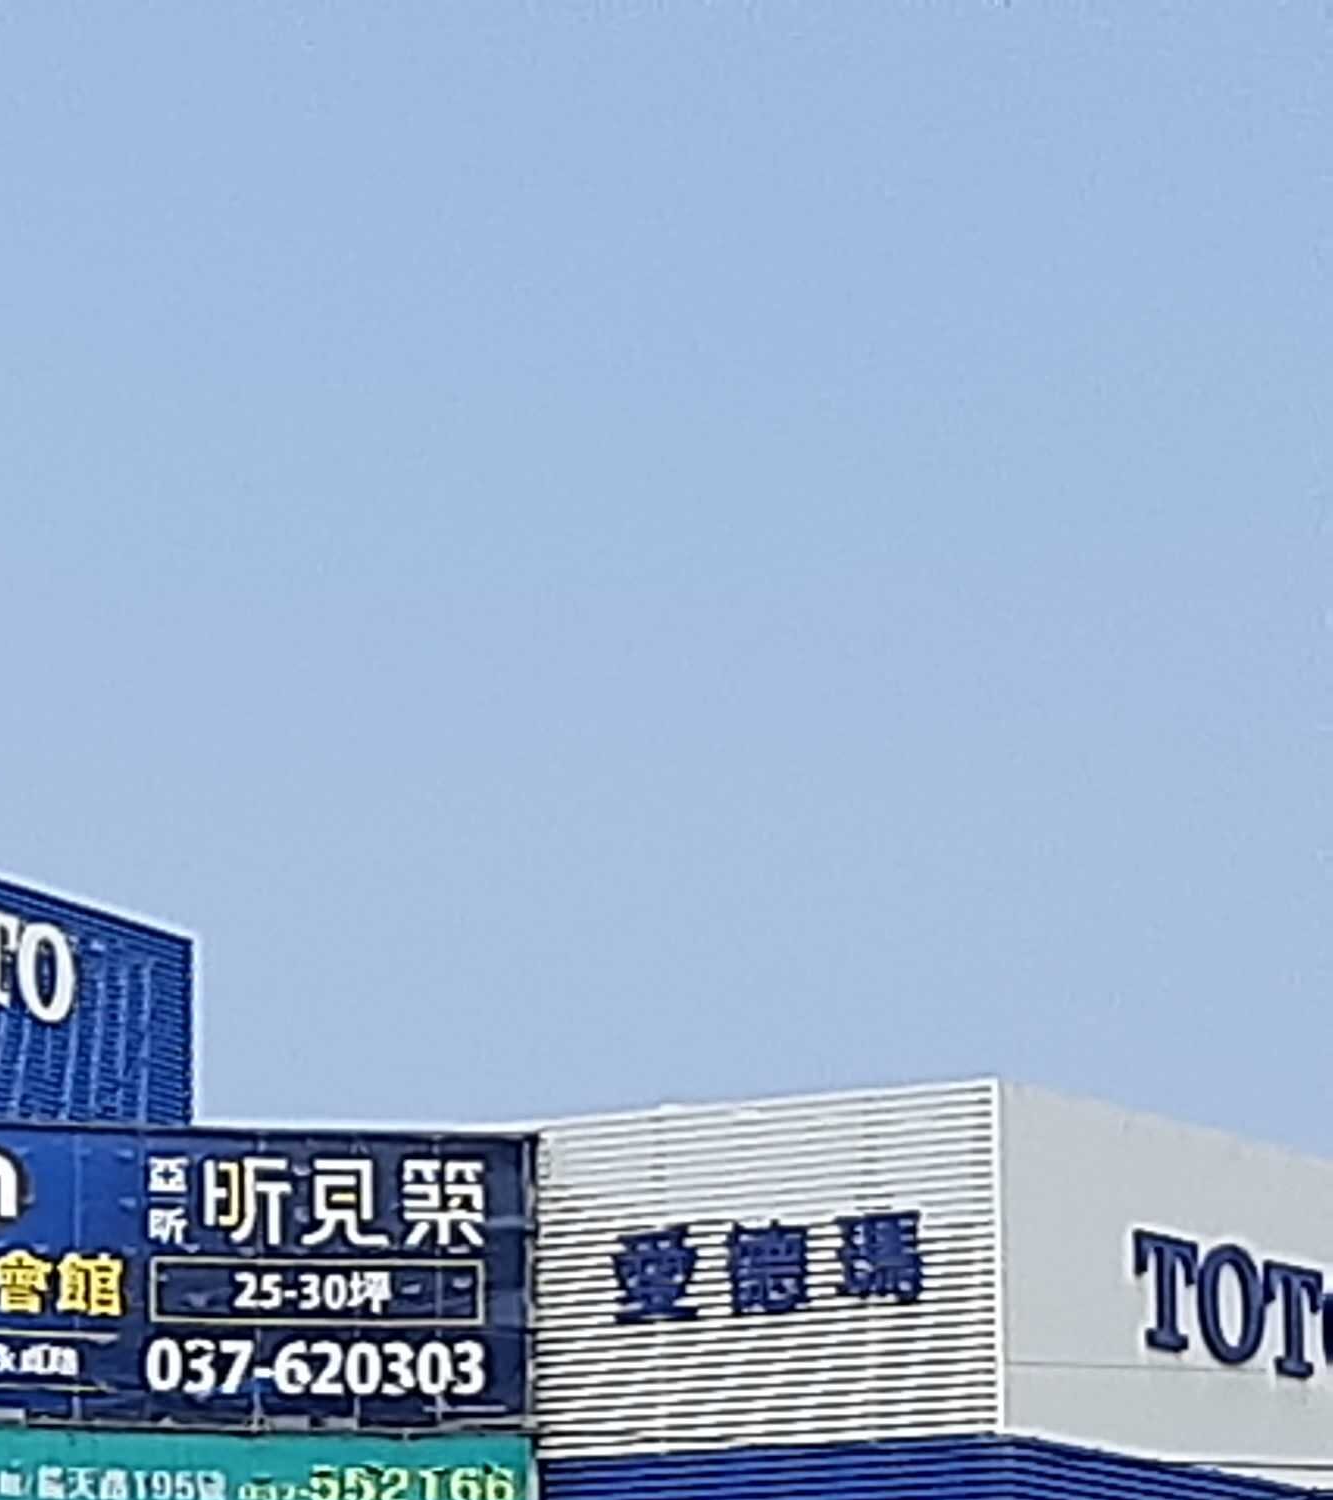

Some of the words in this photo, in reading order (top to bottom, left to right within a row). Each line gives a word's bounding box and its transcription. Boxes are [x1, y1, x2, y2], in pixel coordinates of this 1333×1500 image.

[234, 1271, 391, 1315] 25-30坪
[1133, 1228, 1333, 1380] TOT
[146, 1336, 486, 1397] 037-620303
